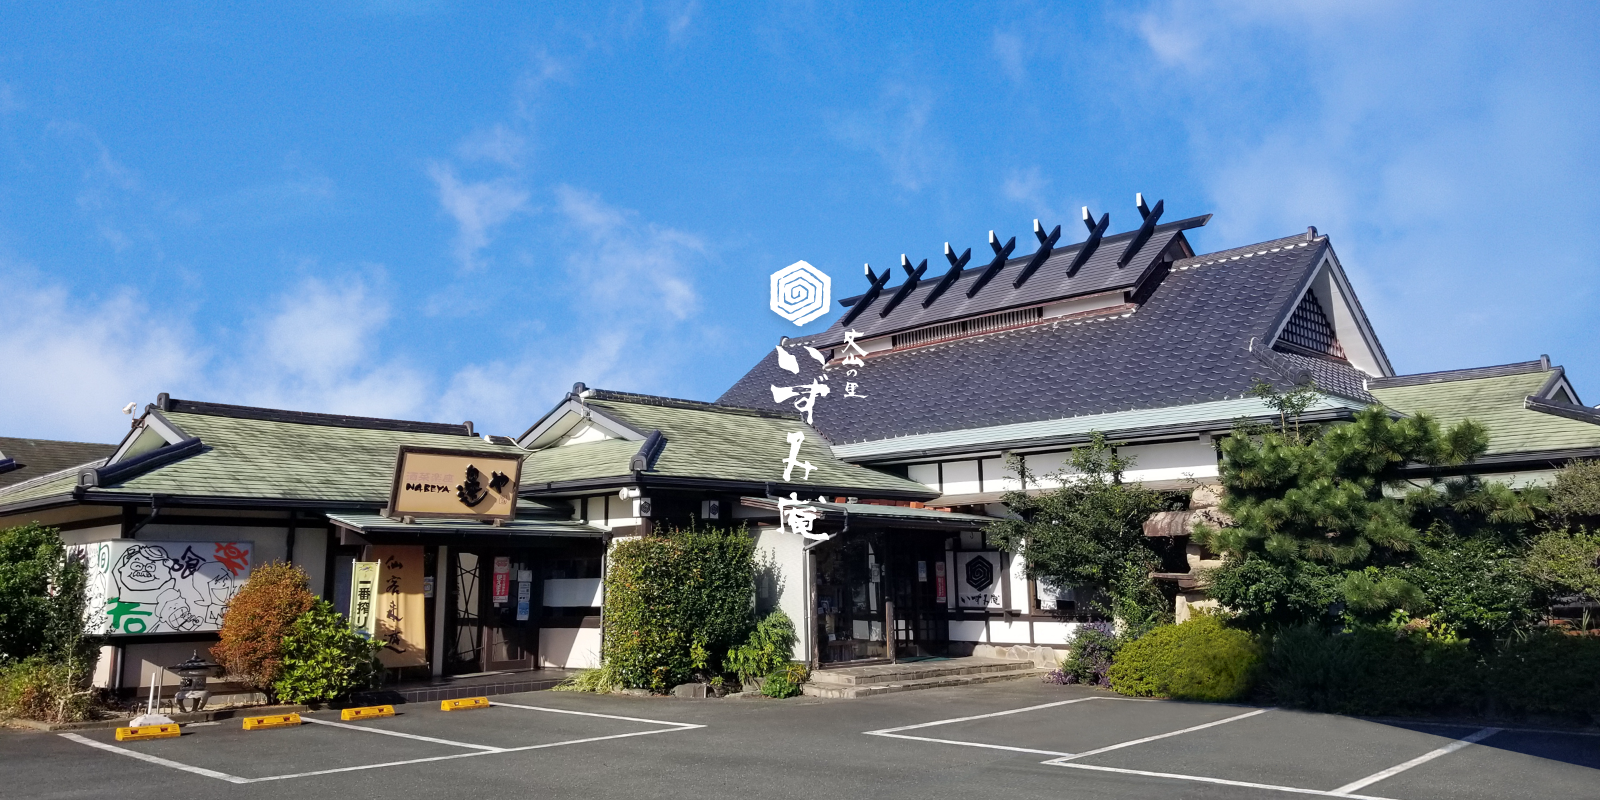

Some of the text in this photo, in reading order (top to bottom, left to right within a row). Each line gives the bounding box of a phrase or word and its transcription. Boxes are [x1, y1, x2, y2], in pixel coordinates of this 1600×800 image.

[405, 482, 451, 494] NABEYA
[356, 580, 371, 628] 一番搾り
[960, 593, 1001, 606] いずみ庵
